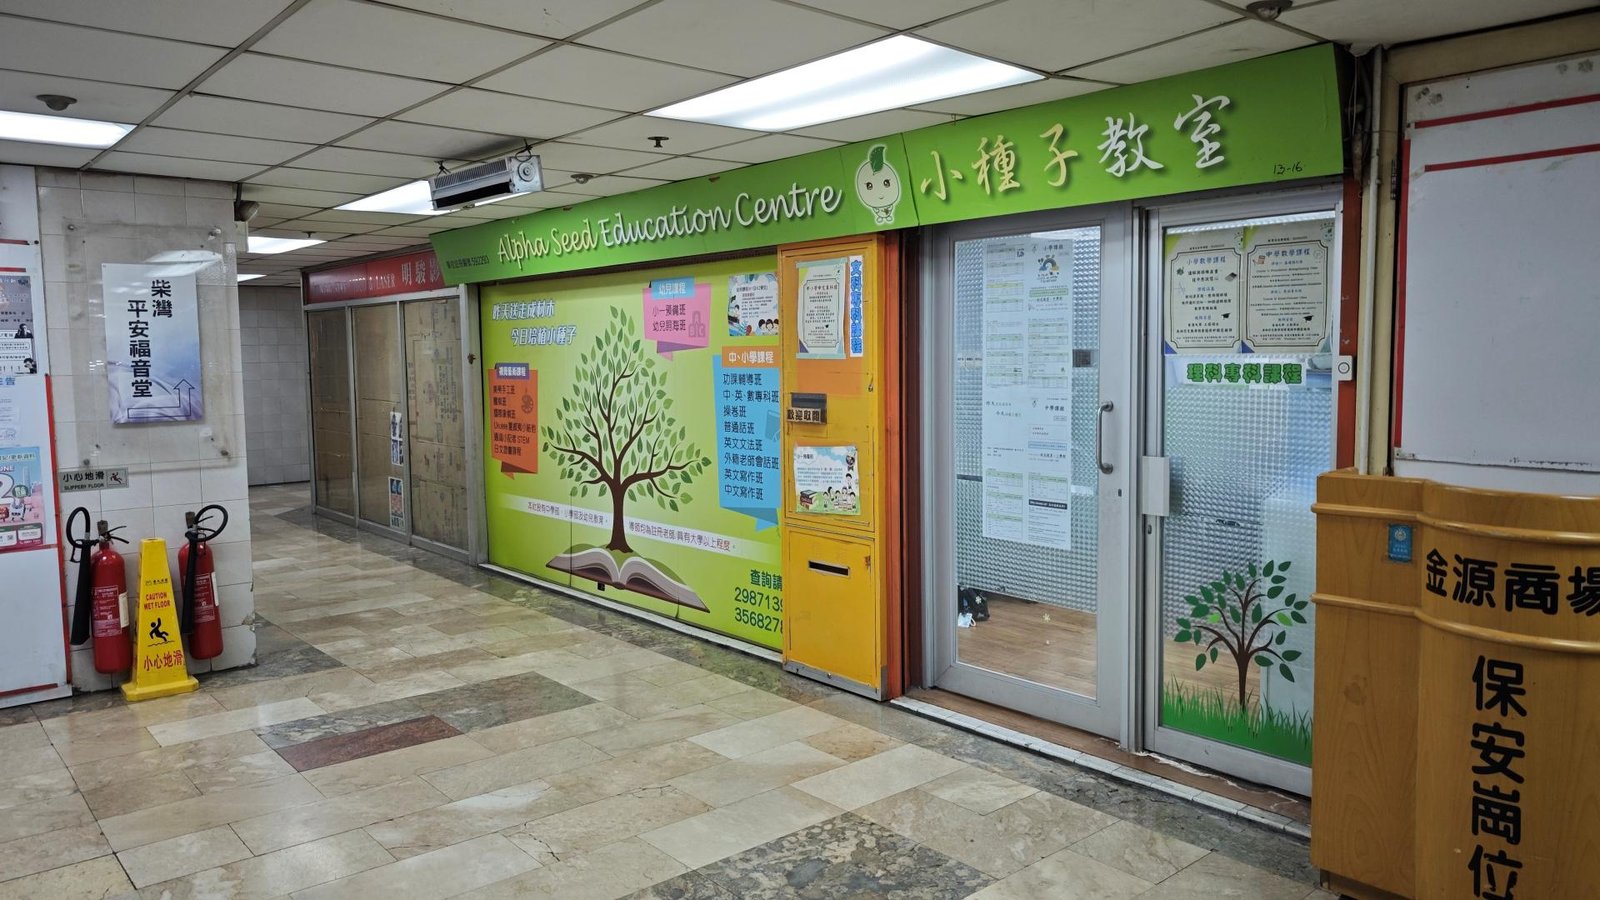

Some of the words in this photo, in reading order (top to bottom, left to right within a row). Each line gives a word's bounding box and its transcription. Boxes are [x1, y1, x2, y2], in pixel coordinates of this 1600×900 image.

[920, 94, 1230, 201] 小種子教室
[1273, 161, 1303, 175] 13-16
[497, 235, 550, 271] Alpha
[551, 218, 598, 255] Seed
[599, 204, 733, 248] Education
[735, 181, 843, 227] Centre
[1266, 248, 1311, 257] 中學數學課程
[659, 282, 686, 295] 幼兒課程
[151, 279, 173, 319] 柴灣
[511, 325, 578, 345] 今日培植小種子
[127, 299, 153, 398] 平安福音堂
[728, 351, 775, 364] 中、小學課程
[723, 373, 762, 386] 功課輔導班
[1187, 363, 1302, 385] 理科專科課程
[724, 421, 755, 435] 普通話班
[724, 437, 763, 451] 英文文法班
[724, 452, 779, 469] 外籍老師會話班
[63, 471, 104, 482] 小心地滑
[724, 468, 763, 484] 英文寫作班
[725, 484, 763, 500] 中文寫作班
[1426, 548, 1600, 616] 金源商場
[146, 592, 167, 600] CAUTION
[735, 587, 783, 612] 298713
[144, 602, 154, 610] WET
[155, 600, 170, 609] FLOOR
[735, 607, 783, 634] 356827
[144, 650, 183, 671] 小心地滑
[1468, 655, 1527, 900] 保安崗位
